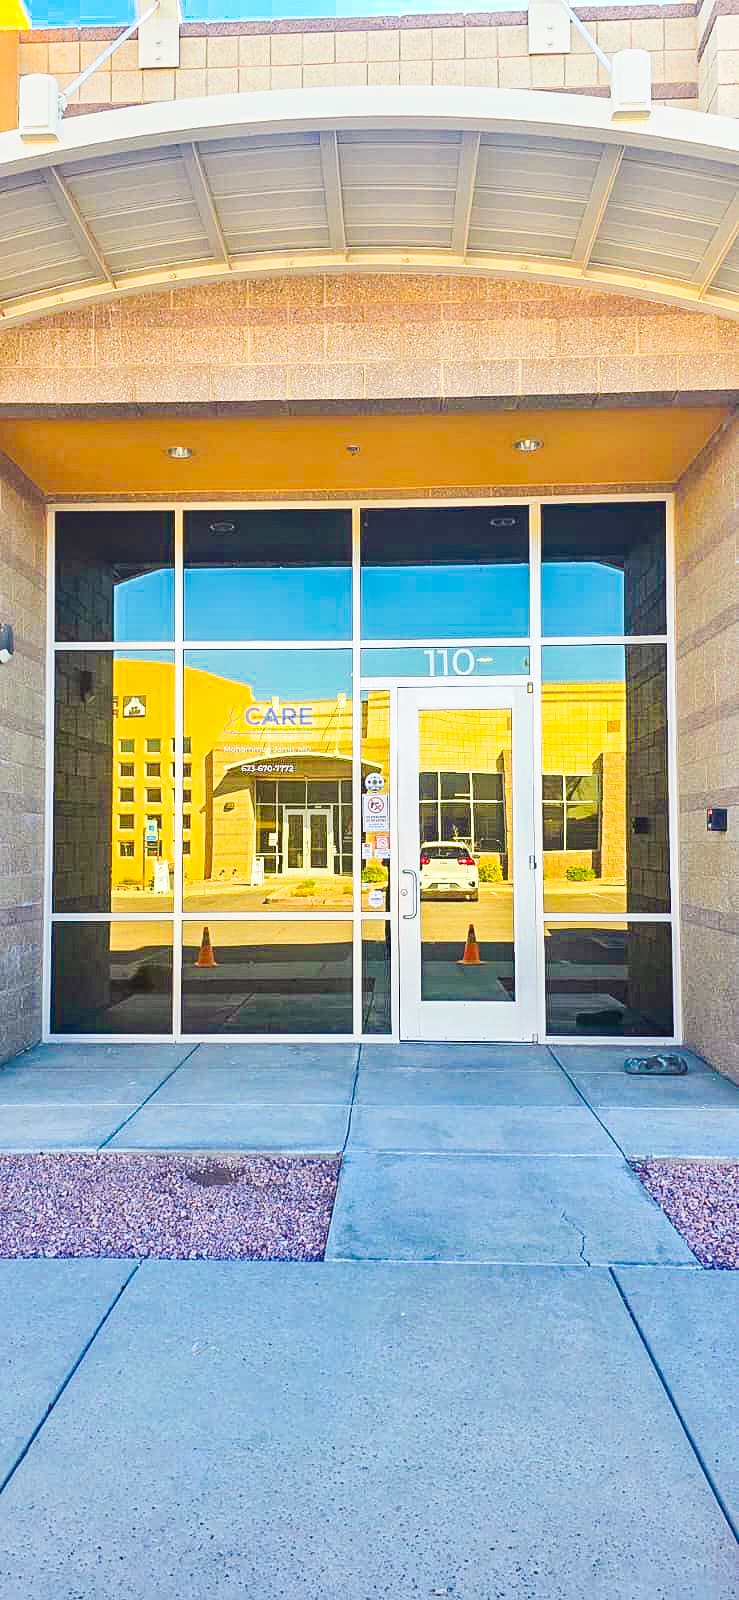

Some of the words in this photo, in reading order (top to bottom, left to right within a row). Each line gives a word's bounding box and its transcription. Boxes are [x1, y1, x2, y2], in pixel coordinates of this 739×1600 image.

[424, 649, 475, 676] 110
[245, 707, 312, 725] CARE
[224, 744, 271, 752] Mohamm
[241, 764, 294, 773] 623-670-7772
